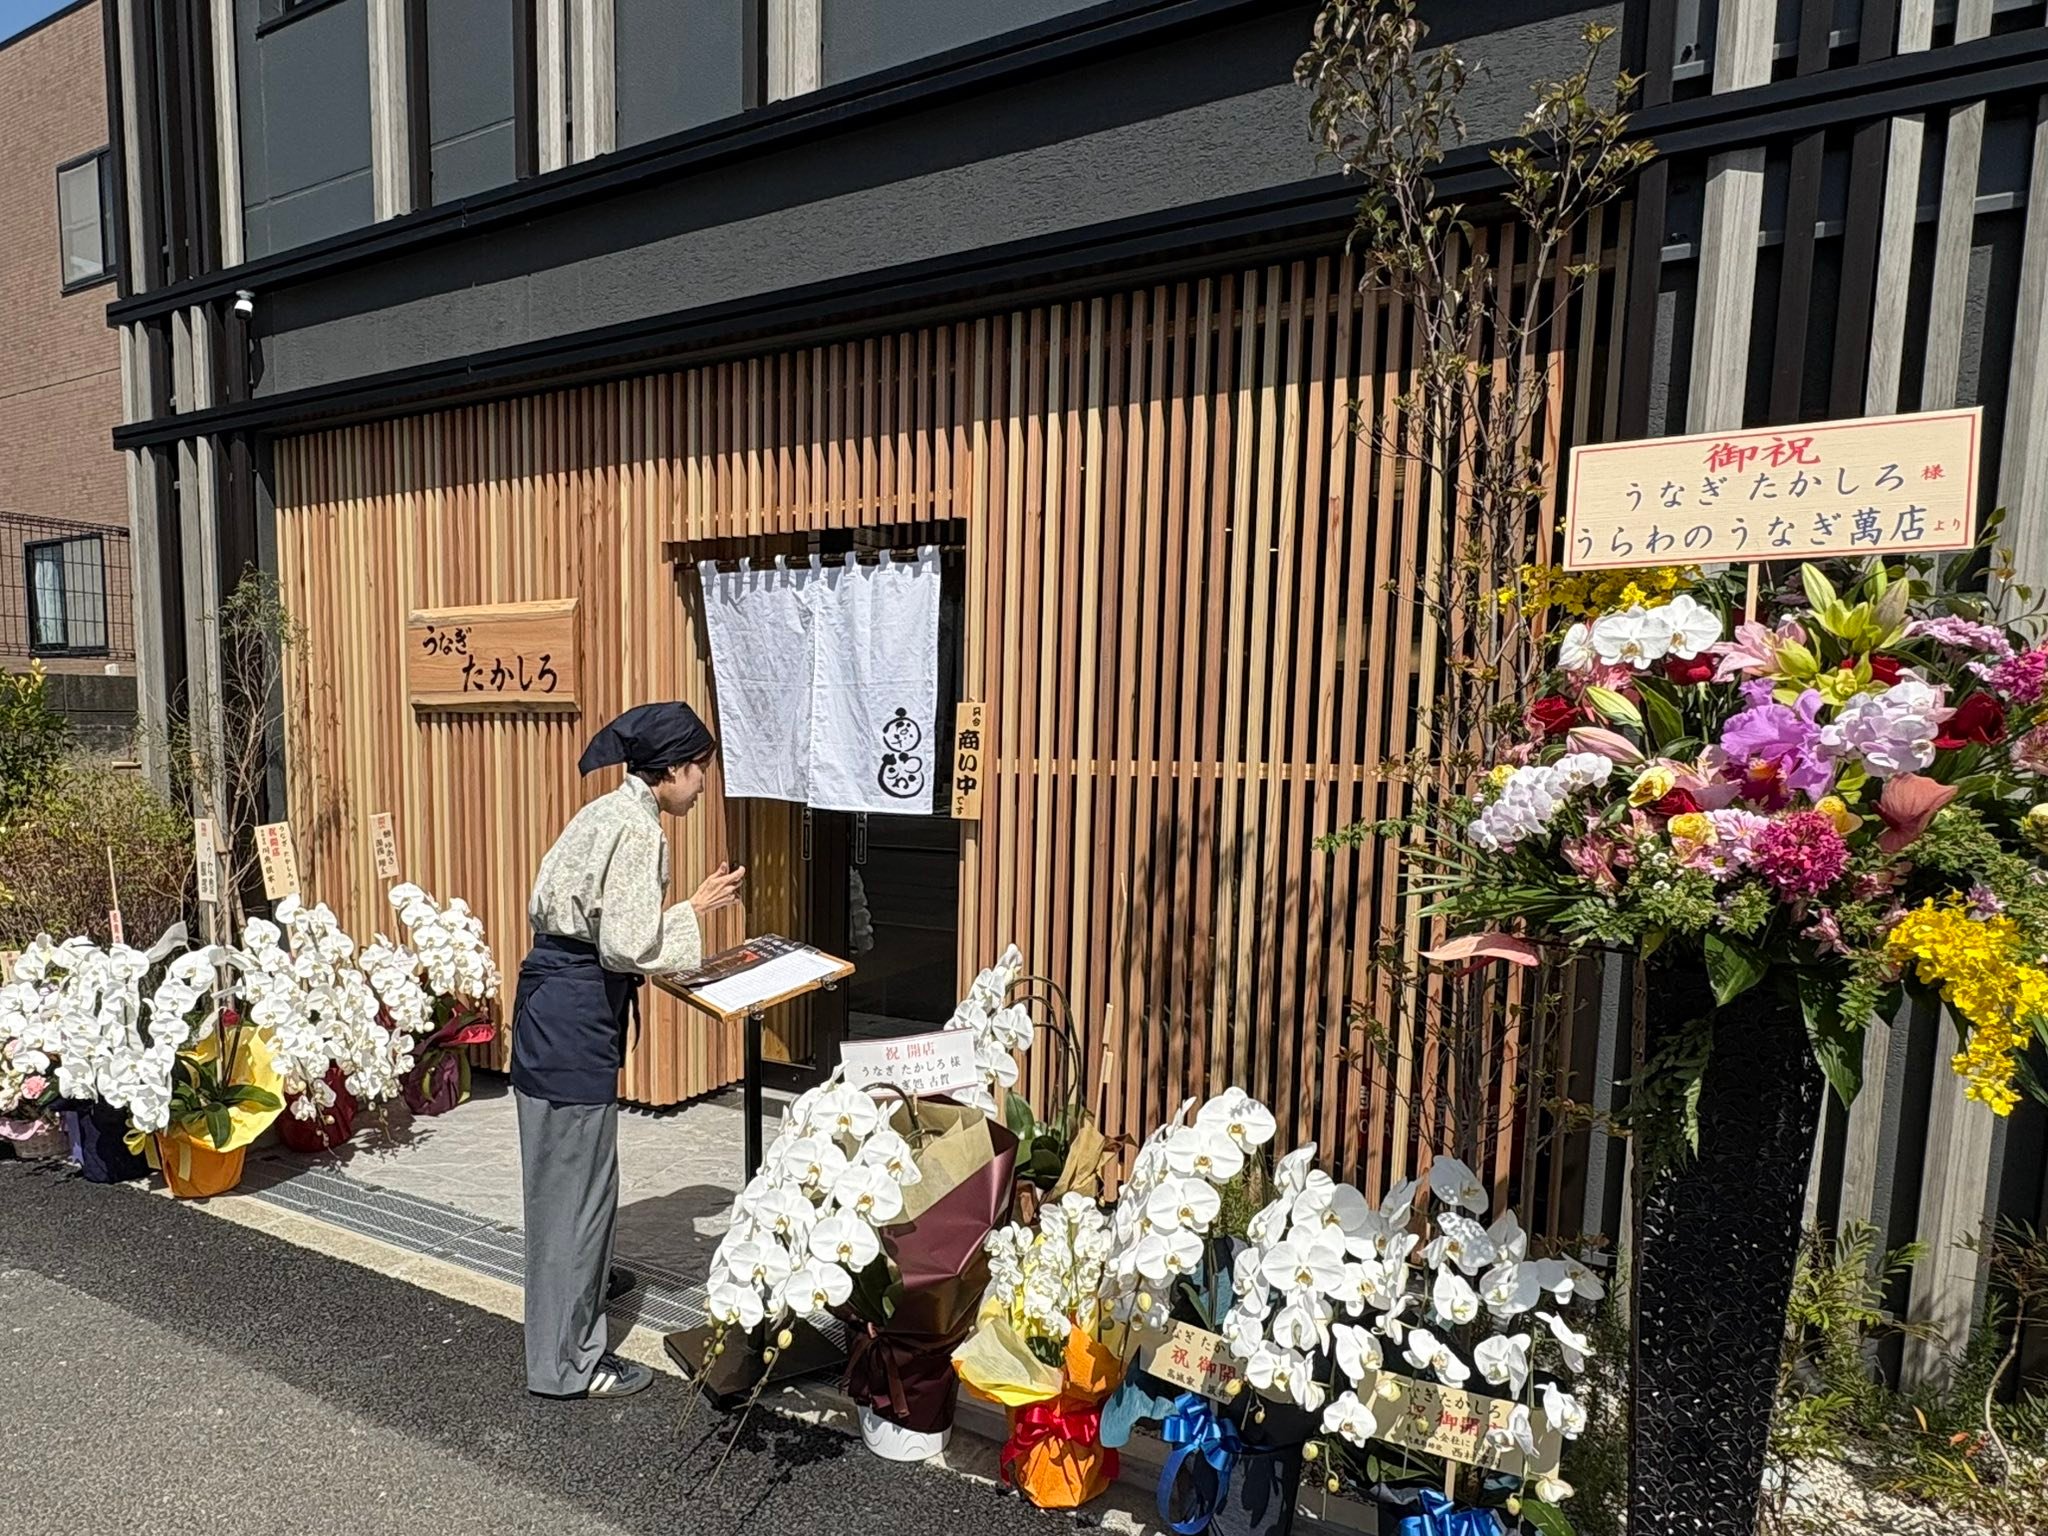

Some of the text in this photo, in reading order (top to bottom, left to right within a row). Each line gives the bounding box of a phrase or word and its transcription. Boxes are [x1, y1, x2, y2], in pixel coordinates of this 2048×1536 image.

[1703, 436, 1821, 473] 御祝
[422, 626, 472, 655] うなぎ
[462, 654, 558, 693] たかしろ
[885, 1046, 900, 1061] 祝
[861, 1064, 895, 1078] うなぎ
[1170, 1345, 1237, 1383] 祝 御開
